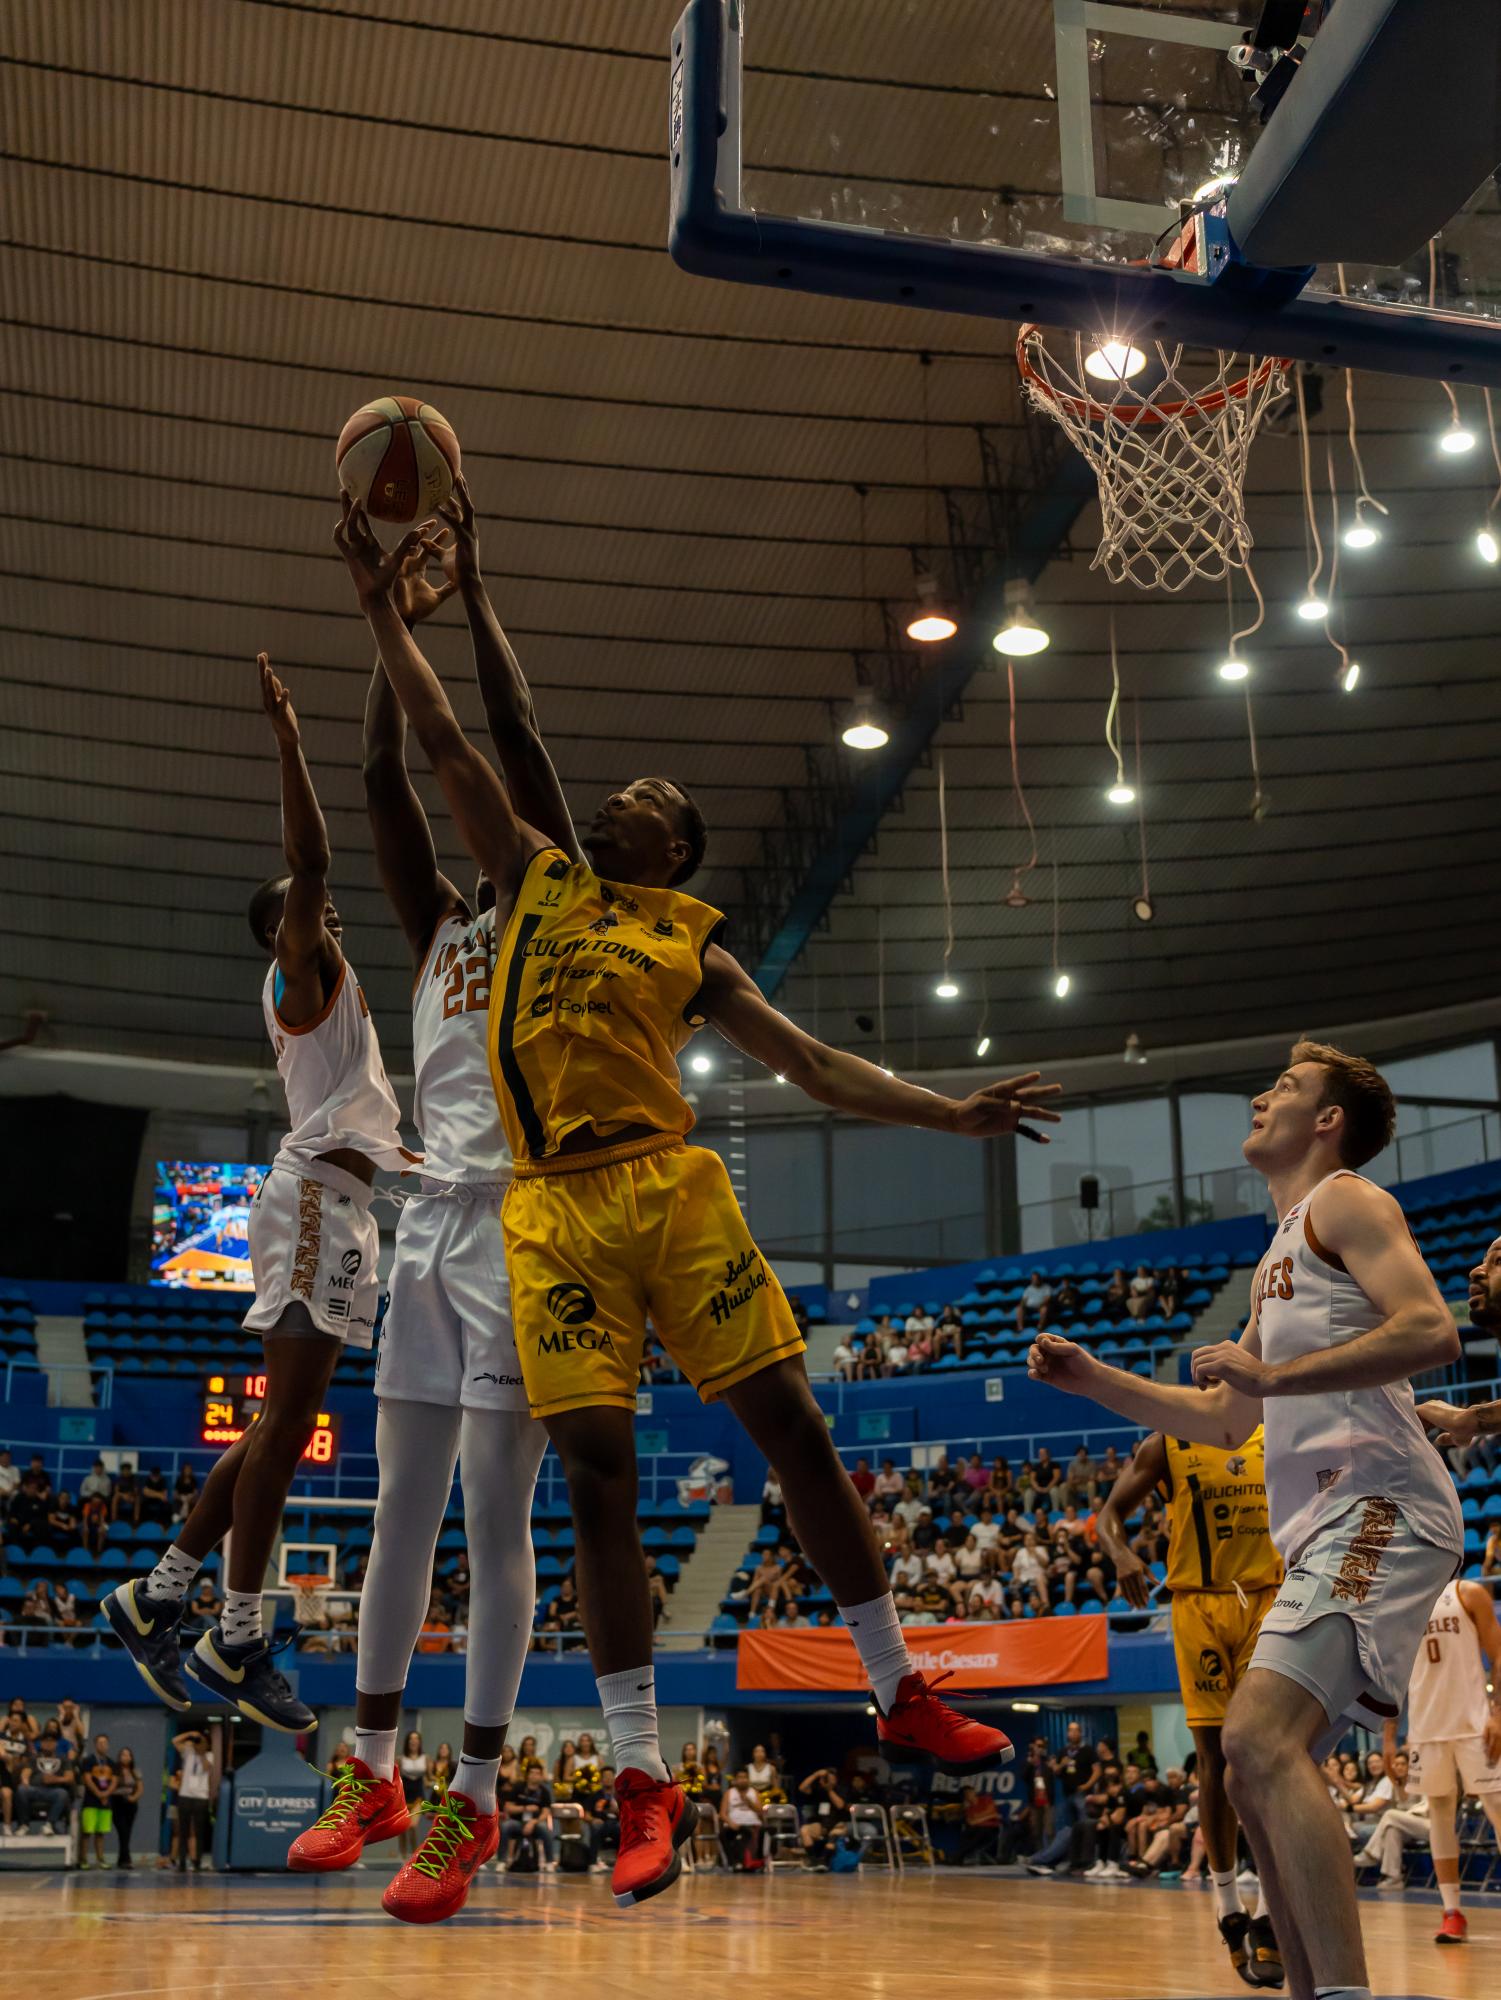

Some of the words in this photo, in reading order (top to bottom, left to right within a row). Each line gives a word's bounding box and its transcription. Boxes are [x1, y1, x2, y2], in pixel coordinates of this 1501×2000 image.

[443, 956, 490, 1020] 22
[559, 998, 615, 1017] Coppel
[724, 1249, 758, 1288] Sala
[537, 1329, 614, 1356] MEGA
[205, 1403, 233, 1426] 24
[1236, 1525, 1269, 1536] Coppe
[1424, 1616, 1460, 1635] ELES
[907, 1651, 938, 1670] ittle
[940, 1649, 999, 1669] Caesars
[1427, 1638, 1441, 1663] 0
[238, 1797, 262, 1808] CITY
[266, 1797, 317, 1809] EXPRESS
